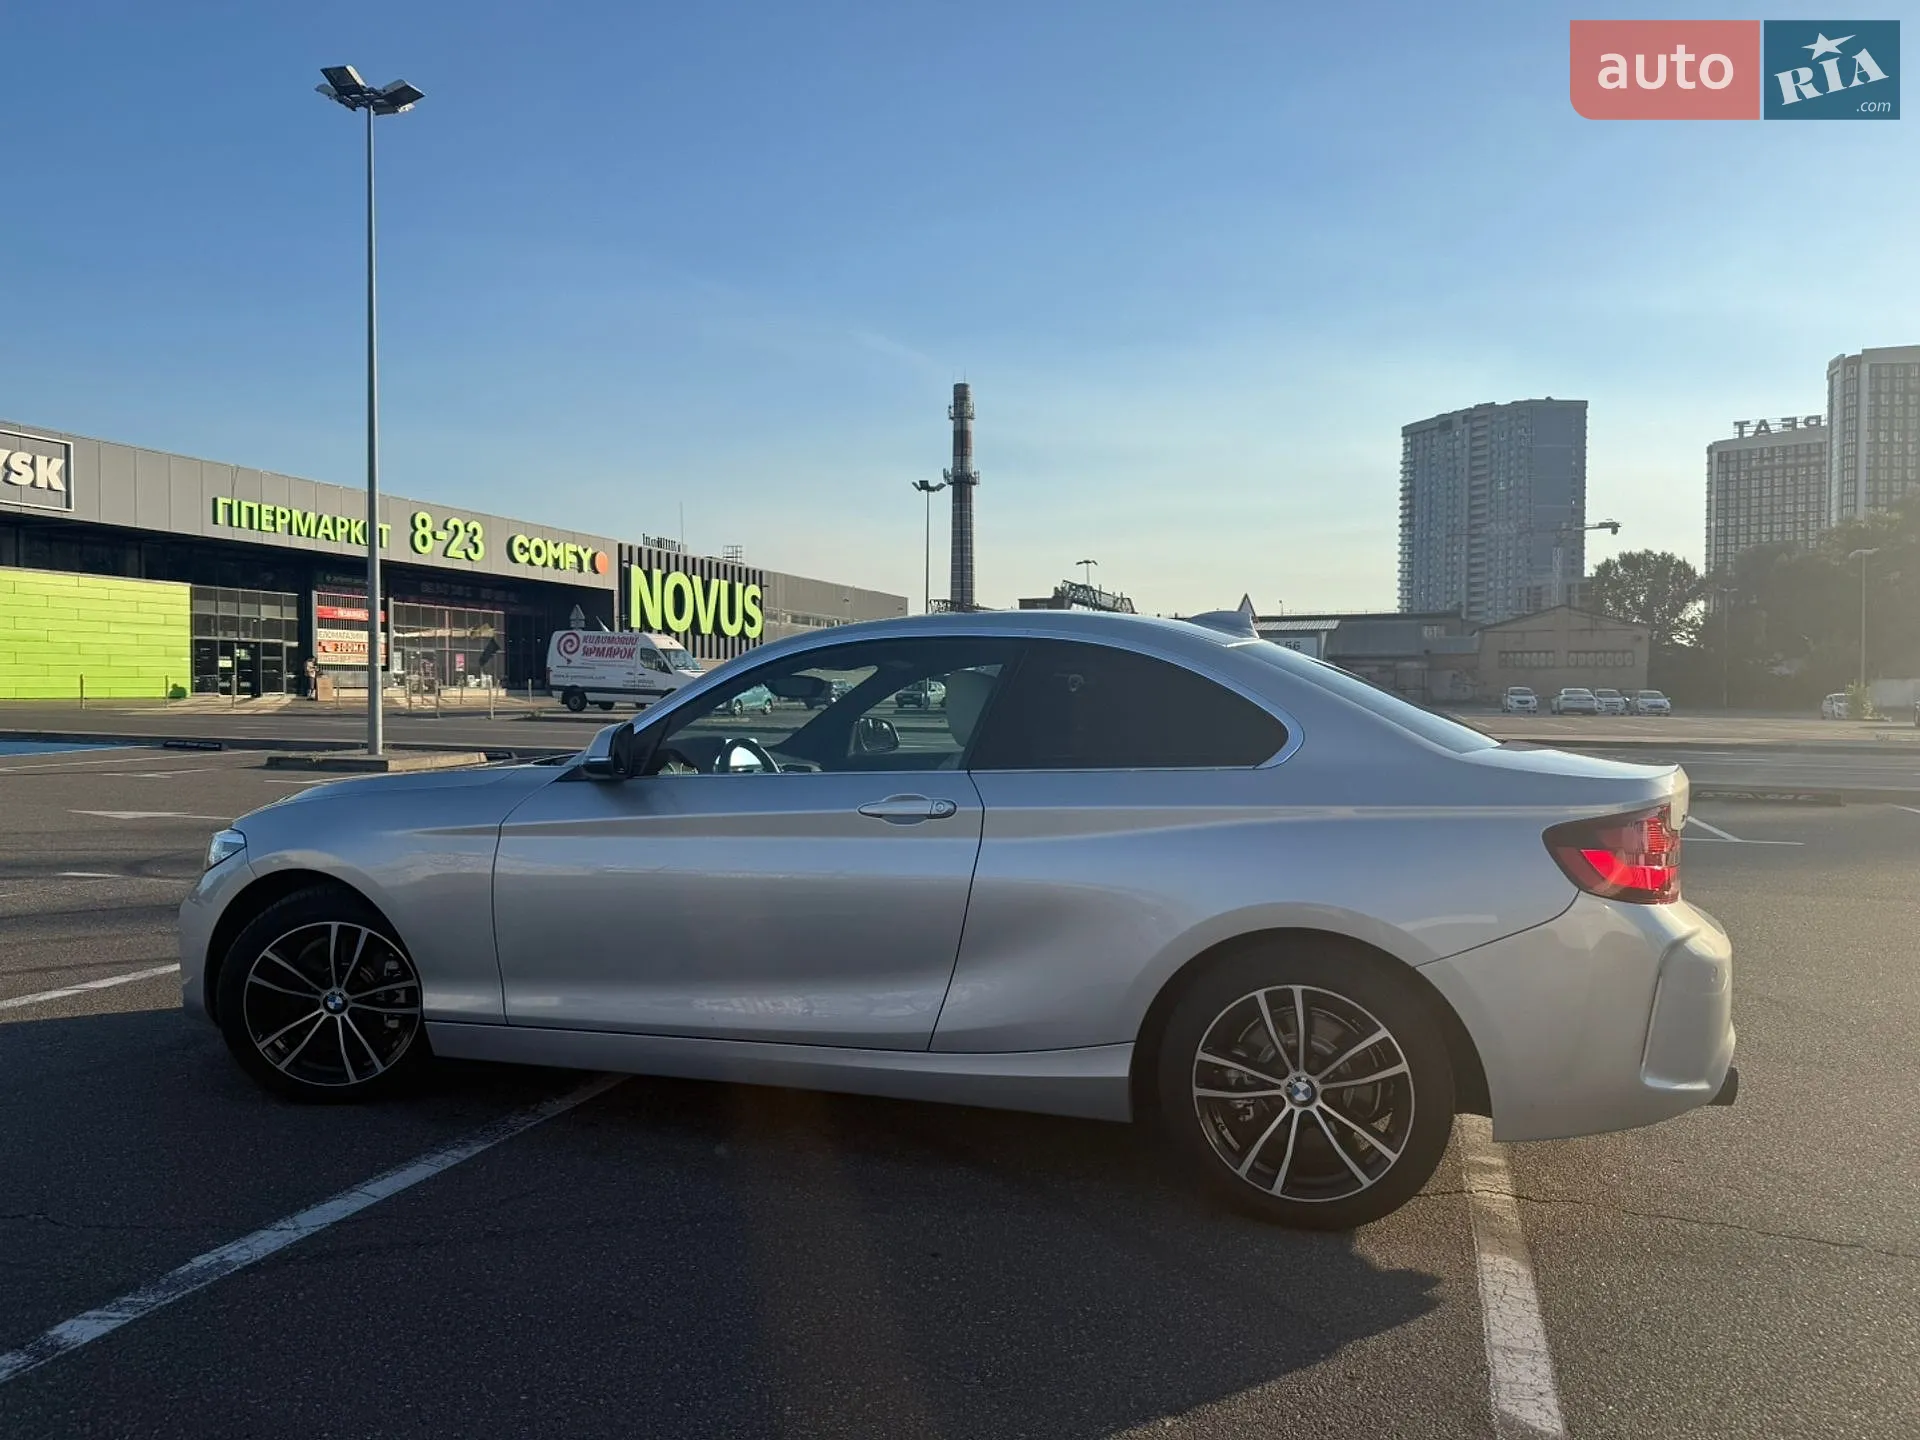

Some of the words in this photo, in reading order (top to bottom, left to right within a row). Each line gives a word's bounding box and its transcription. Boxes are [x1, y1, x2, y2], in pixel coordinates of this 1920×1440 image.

[216, 496, 392, 549] ГІПЕРМАРКТ
[413, 511, 485, 562] 8-23
[511, 533, 592, 573] COMFY
[630, 564, 764, 639] NOVUS
[581, 645, 636, 660] ЯРМАРОК
